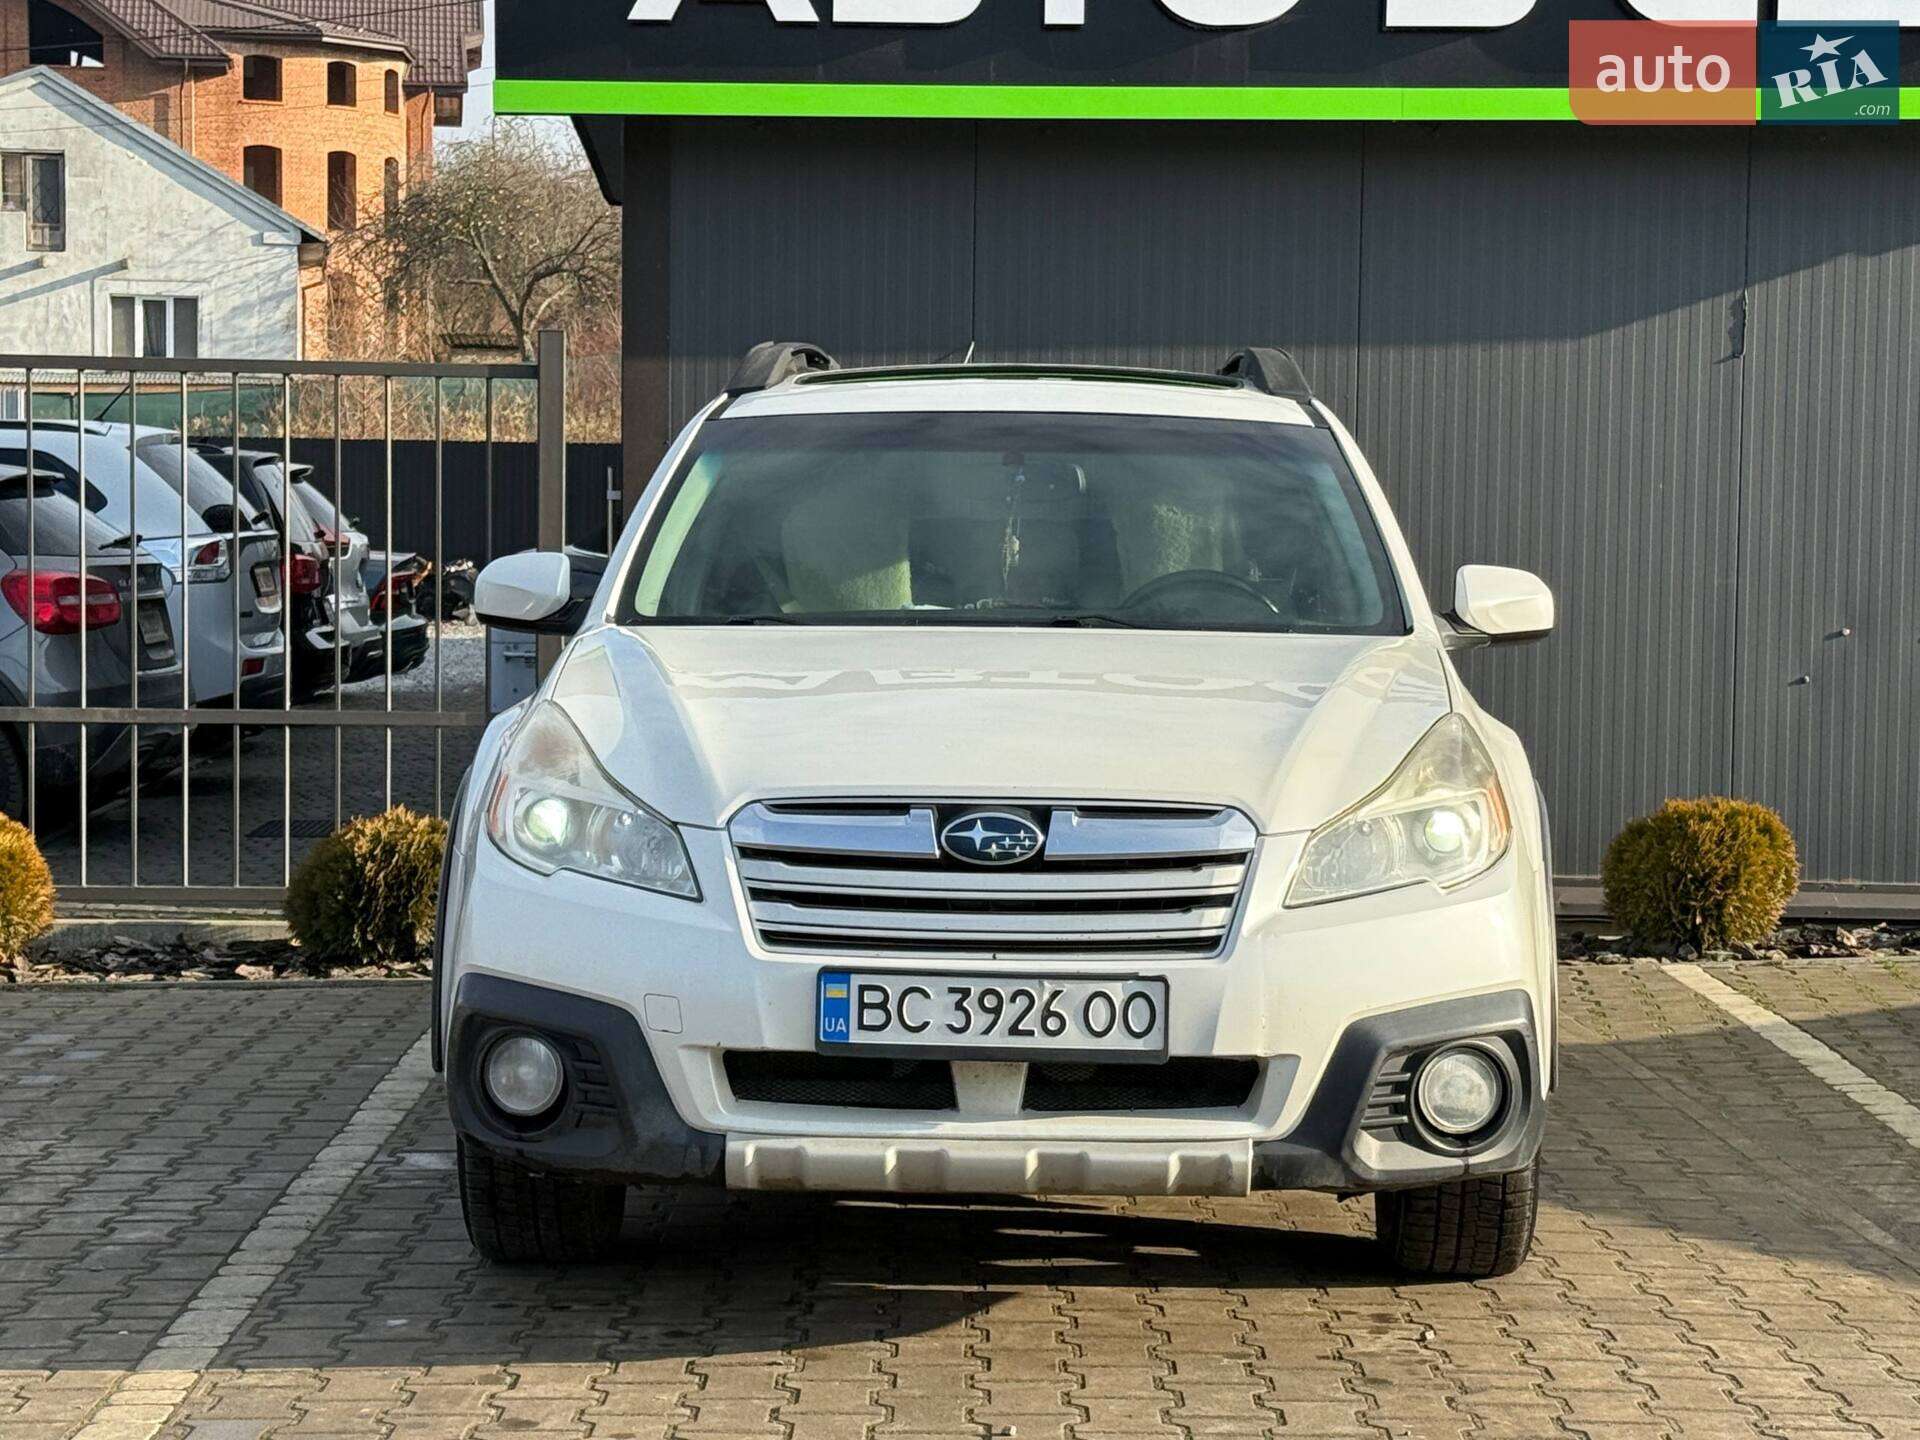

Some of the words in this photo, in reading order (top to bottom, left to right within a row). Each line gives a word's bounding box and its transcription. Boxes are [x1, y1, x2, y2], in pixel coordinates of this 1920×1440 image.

[824, 1018, 847, 1033] UA
[857, 984, 932, 1033] BC
[945, 987, 1068, 1038] 3926
